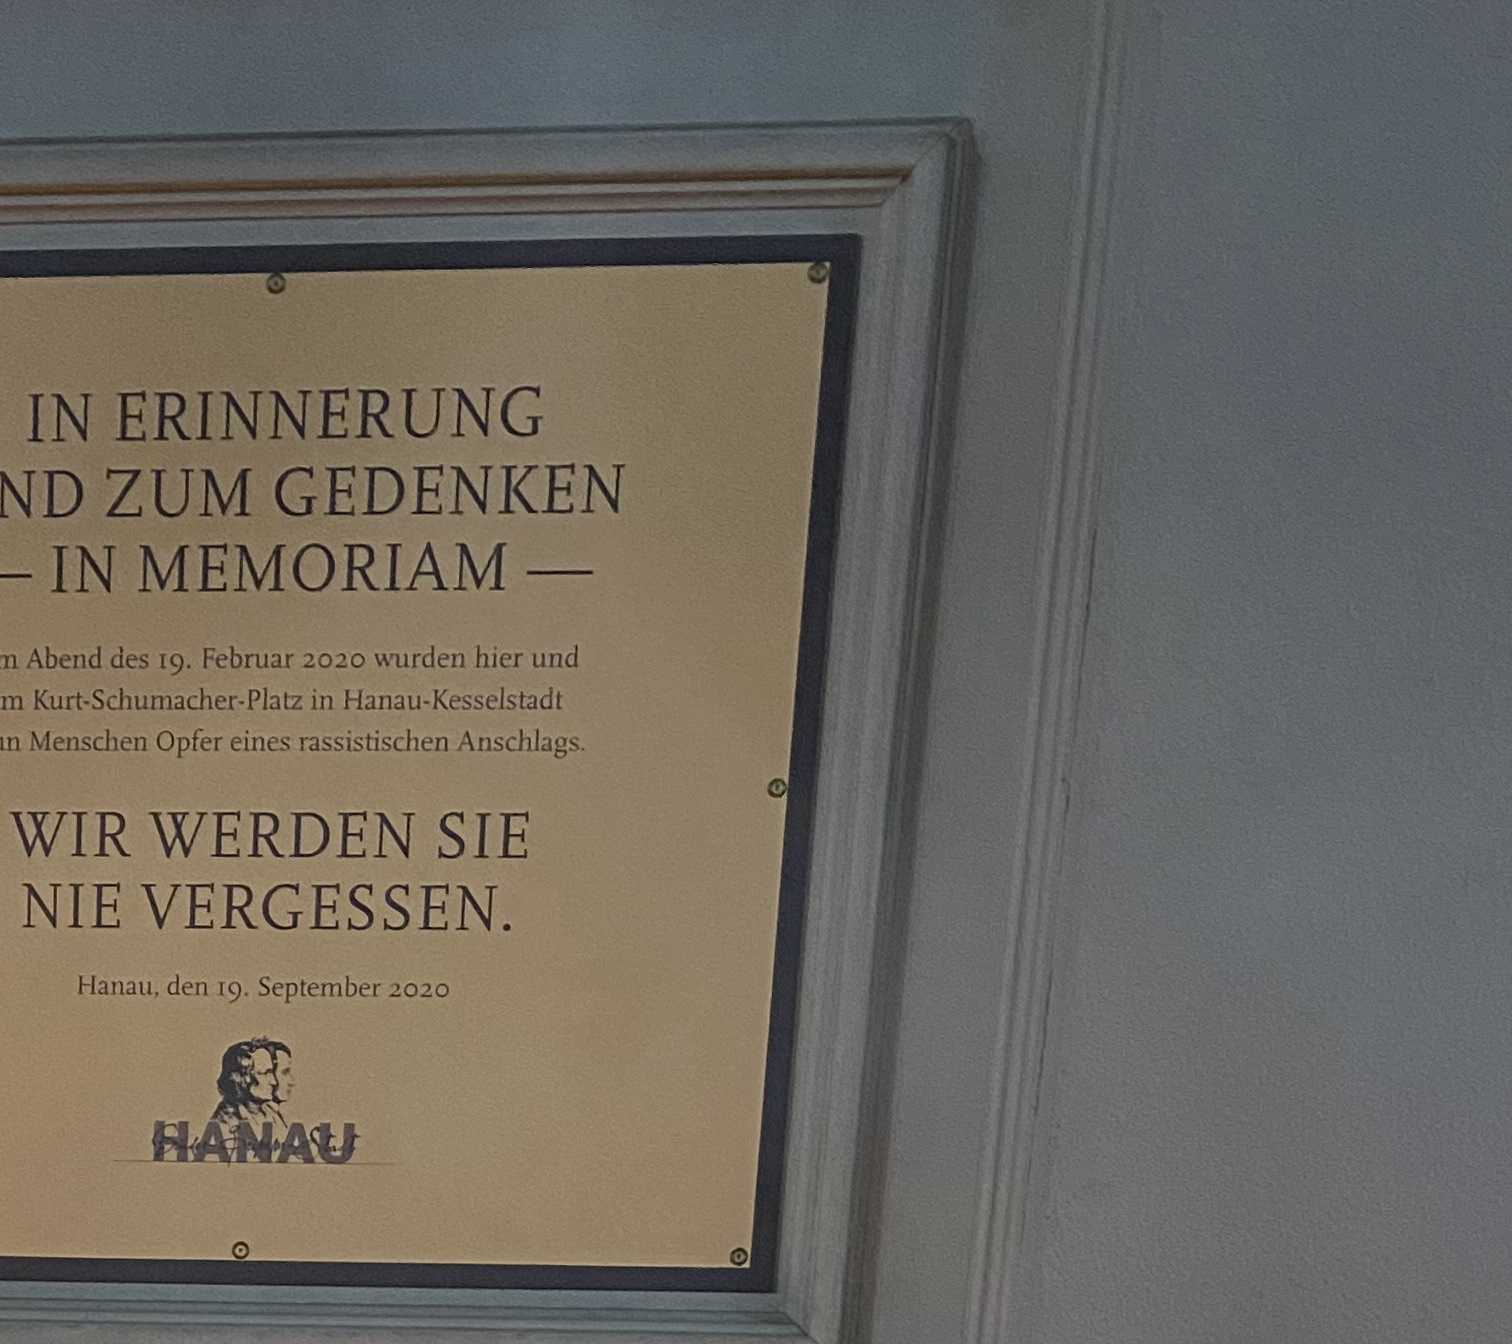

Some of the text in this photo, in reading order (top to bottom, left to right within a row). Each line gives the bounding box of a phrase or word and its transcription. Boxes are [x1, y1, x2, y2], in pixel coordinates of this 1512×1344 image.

[27, 385, 543, 444] IN ERINNERUNG
[105, 467, 253, 519] ZUM
[274, 462, 626, 518] GEDENKEN
[51, 541, 507, 594] IN MEMORIAM
[25, 645, 103, 671] Abend
[109, 645, 150, 670] des
[159, 652, 192, 677] 19.
[202, 645, 295, 670] Februar
[302, 652, 366, 670] 2020
[373, 644, 466, 669] wurden
[475, 644, 524, 669] hier
[532, 644, 580, 669] und
[33, 686, 303, 712] Kurt-Schumacher-Platz
[310, 688, 334, 711] in
[343, 686, 563, 711] Hanau-Kesselstadt
[29, 728, 148, 753] Menschen
[155, 727, 224, 760] Opfer
[229, 729, 291, 753] eines
[299, 728, 450, 753] rassistischen
[456, 728, 586, 761] Anschlags.
[9, 810, 530, 860] WIR WERDEN SIE
[21, 882, 512, 932] NIE VERGESSEN.
[77, 973, 450, 1005] Hanau, den 19. September 2020
[152, 1120, 356, 1164] HANAU
